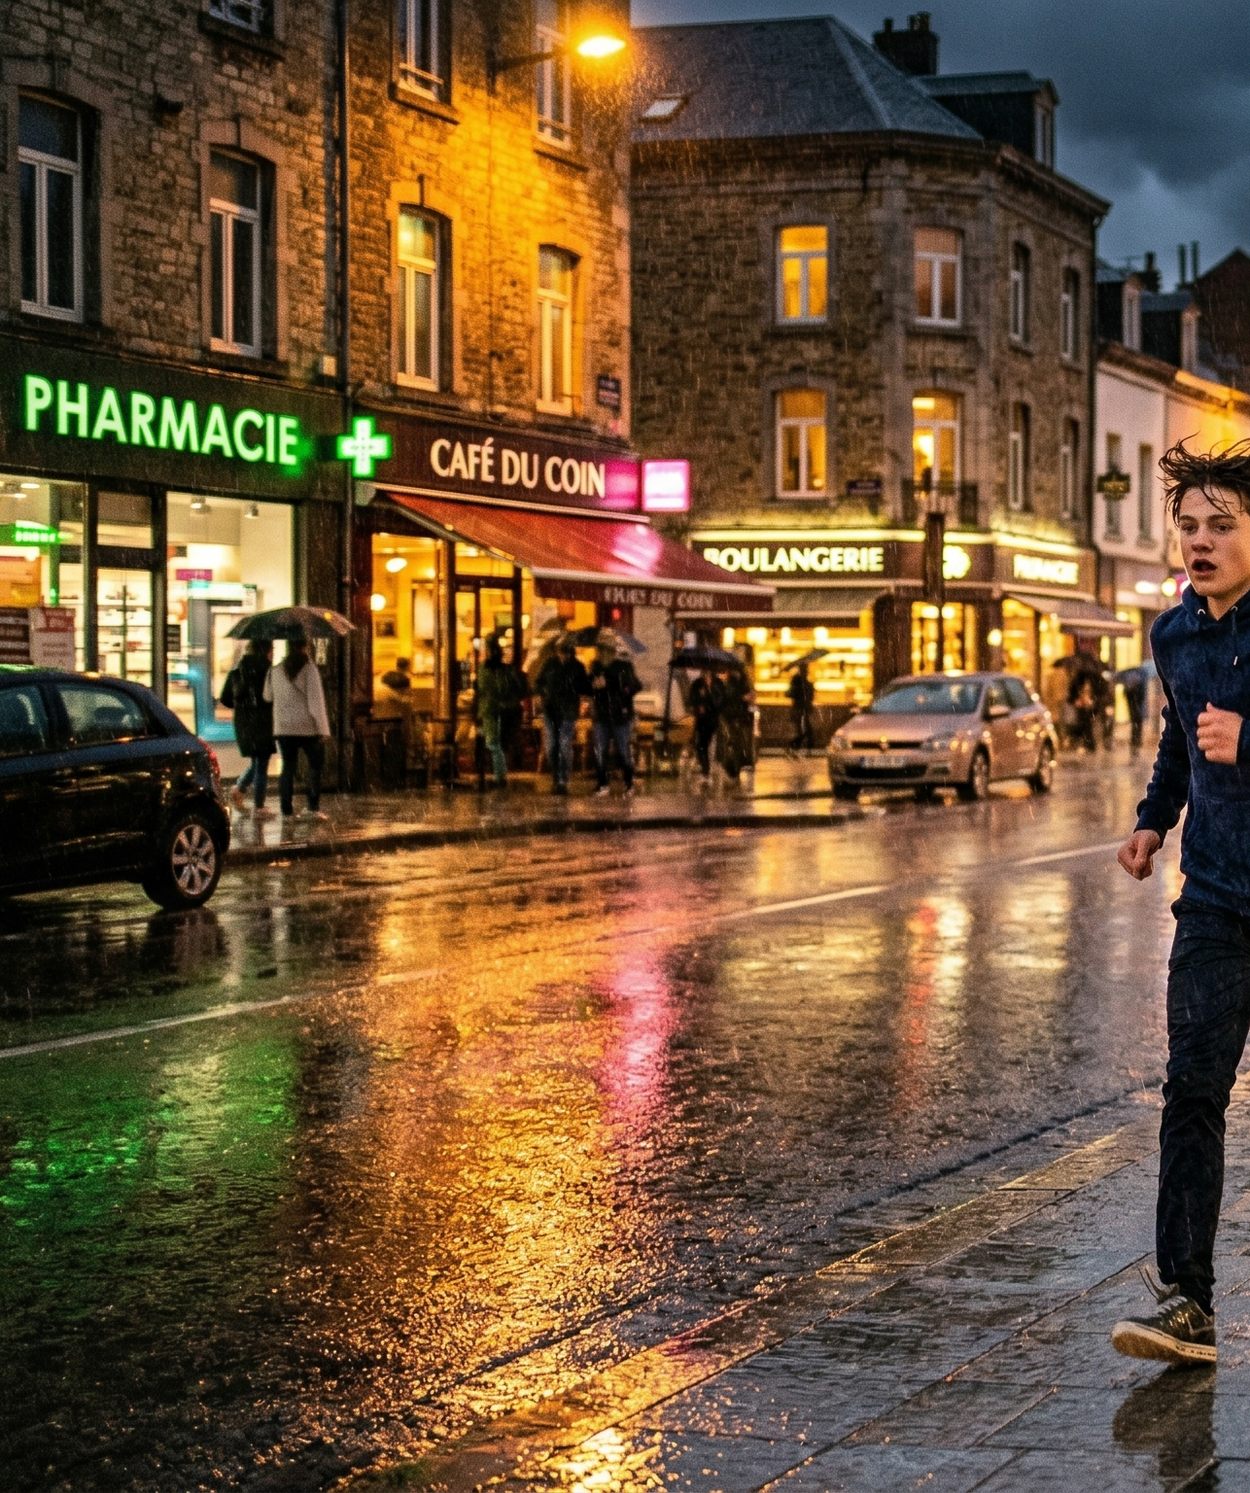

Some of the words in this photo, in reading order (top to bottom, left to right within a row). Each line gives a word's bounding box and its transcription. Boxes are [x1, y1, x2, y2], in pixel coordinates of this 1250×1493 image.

[25, 374, 298, 465] PHARMACIE
[430, 437, 495, 482] CAFÉ
[501, 449, 539, 489] DU
[544, 456, 605, 499] COIN
